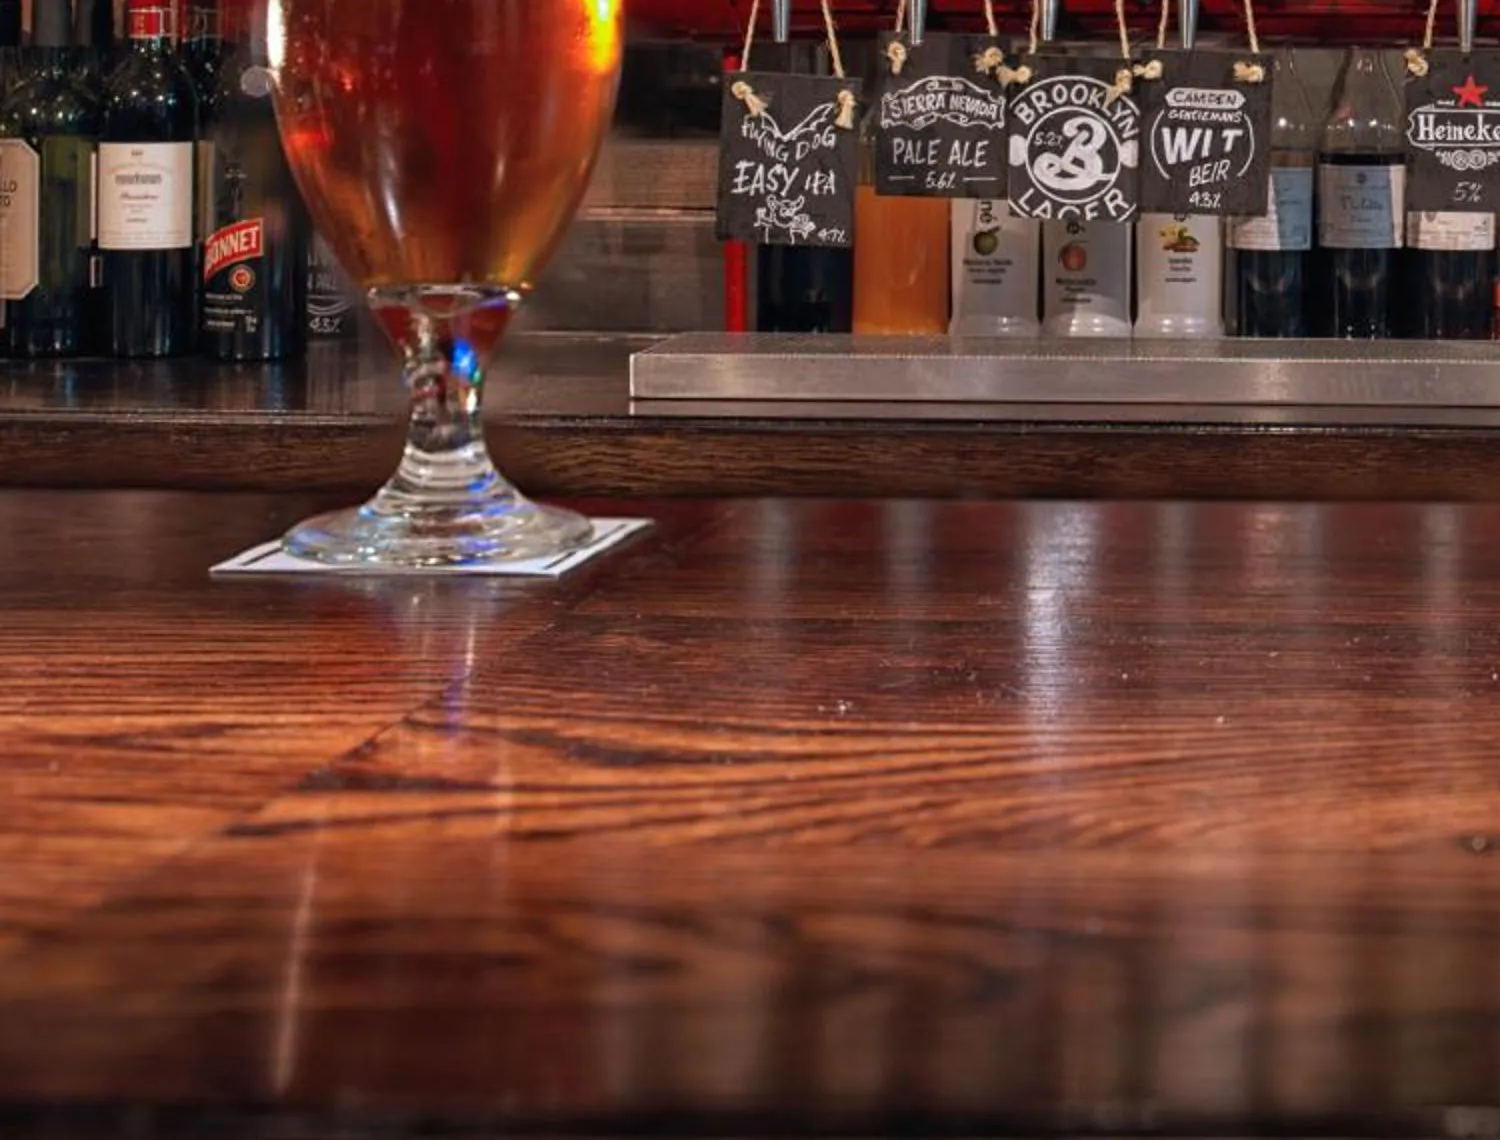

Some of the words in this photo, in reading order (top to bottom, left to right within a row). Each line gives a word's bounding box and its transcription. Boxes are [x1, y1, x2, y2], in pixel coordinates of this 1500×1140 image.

[890, 92, 946, 118] SIERRA
[949, 93, 998, 120] NEVADA
[1014, 83, 1139, 139] BROOKLYN
[1173, 91, 1237, 106] CAMDEN
[1168, 109, 1243, 123] GENTLEMANS
[741, 114, 788, 161] FLYING
[796, 125, 836, 160] DOG
[892, 138, 942, 166] PALE
[948, 137, 990, 167] ALE
[1161, 127, 1244, 165] WIT
[731, 160, 800, 197] EASY
[804, 170, 836, 196] IPA
[1454, 181, 1482, 202] 5%
